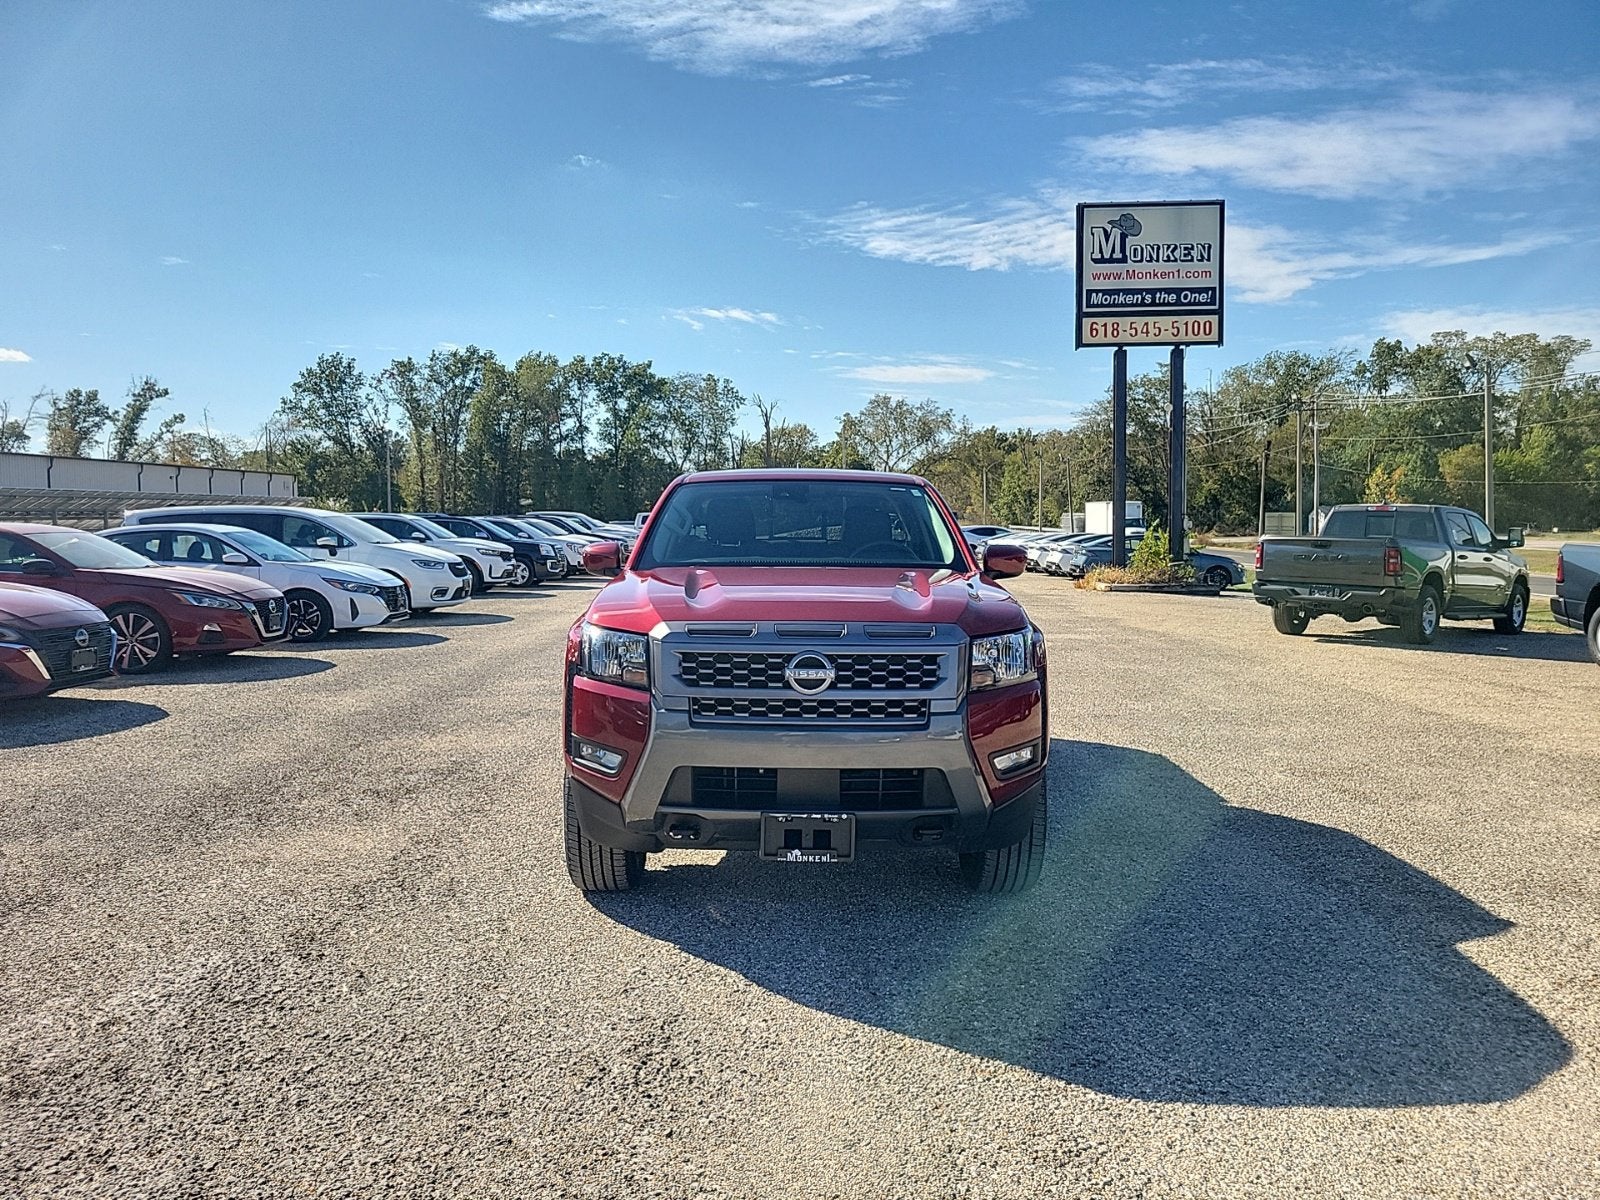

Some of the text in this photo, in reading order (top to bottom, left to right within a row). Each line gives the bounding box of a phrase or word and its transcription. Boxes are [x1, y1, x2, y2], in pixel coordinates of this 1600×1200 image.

[1090, 226, 1212, 264] MONKEN
[1091, 269, 1212, 281] www.Monken1.com
[1090, 290, 1212, 305] Monken's the One!
[1089, 319, 1213, 338] 618-545-5100
[786, 670, 834, 678] NISSAN
